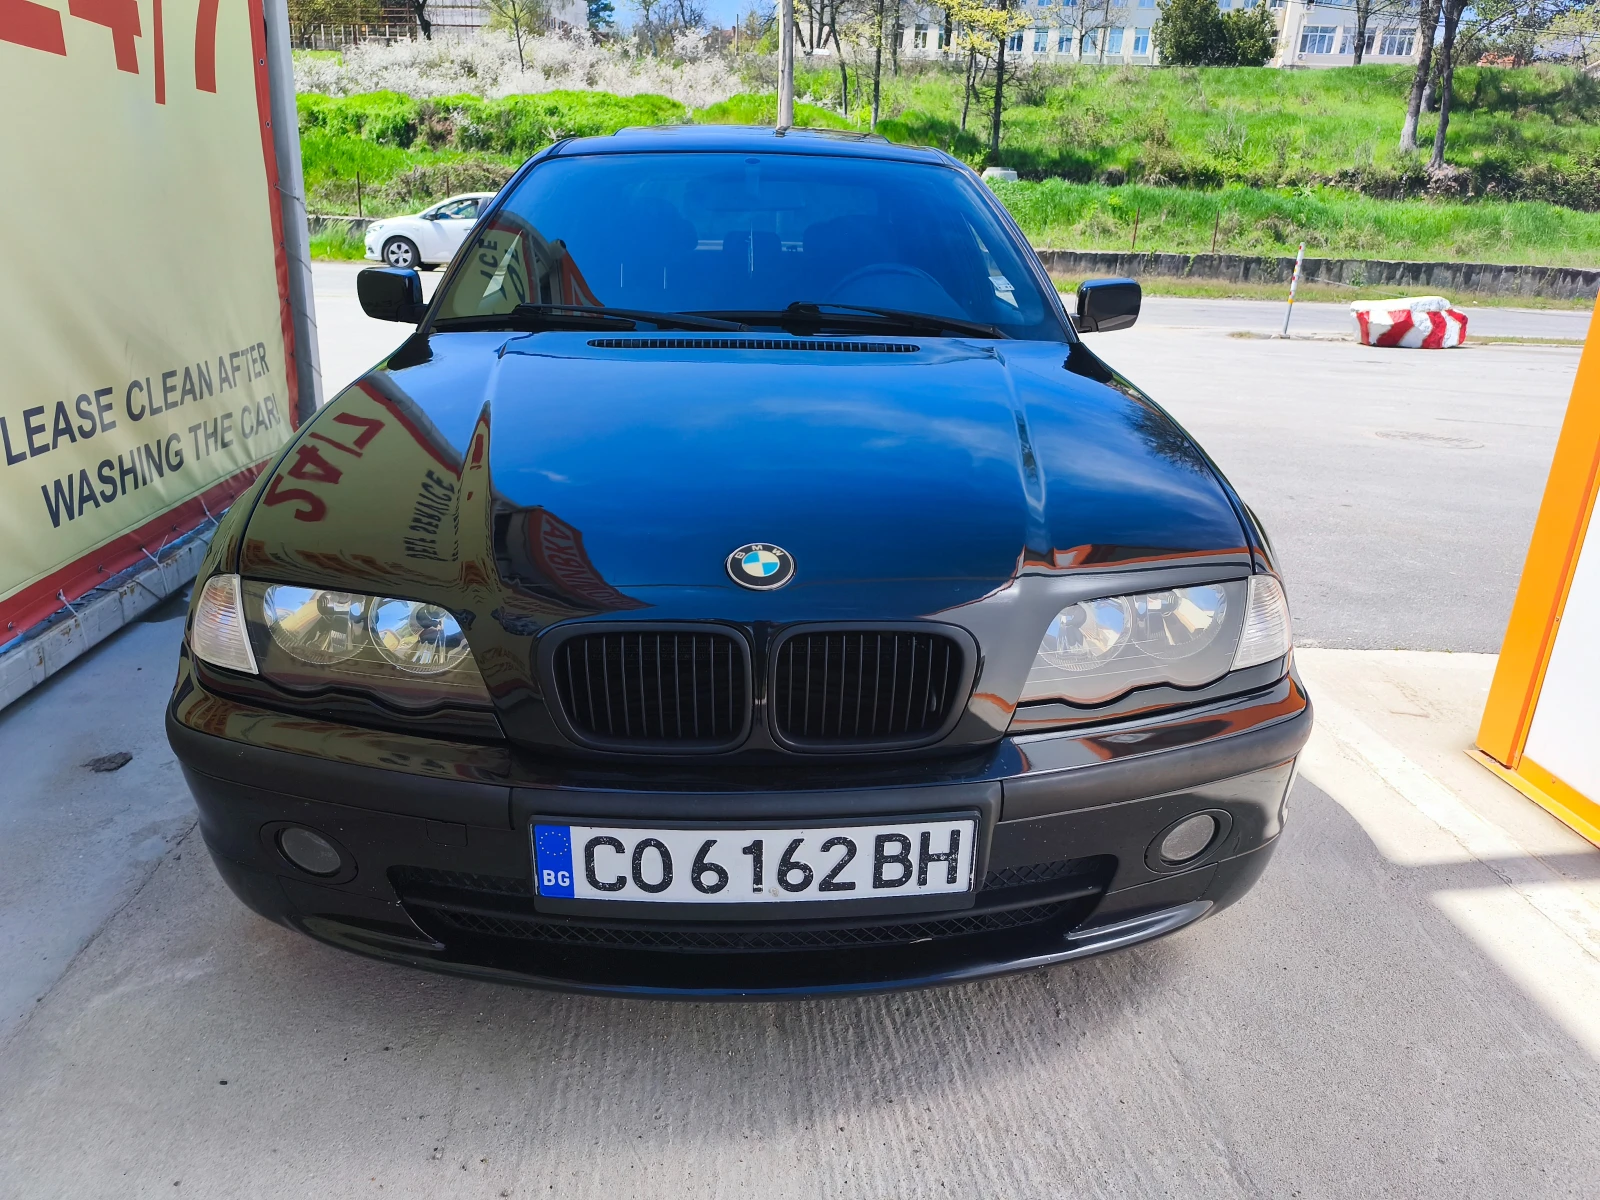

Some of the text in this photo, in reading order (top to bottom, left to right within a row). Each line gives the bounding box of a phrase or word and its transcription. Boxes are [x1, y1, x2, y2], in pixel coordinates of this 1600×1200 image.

[125, 360, 214, 422] CLEAN
[218, 341, 270, 394] AFTER
[41, 392, 281, 529] WASHING THE CAR!
[734, 544, 785, 559] BMW
[542, 869, 571, 887] BG
